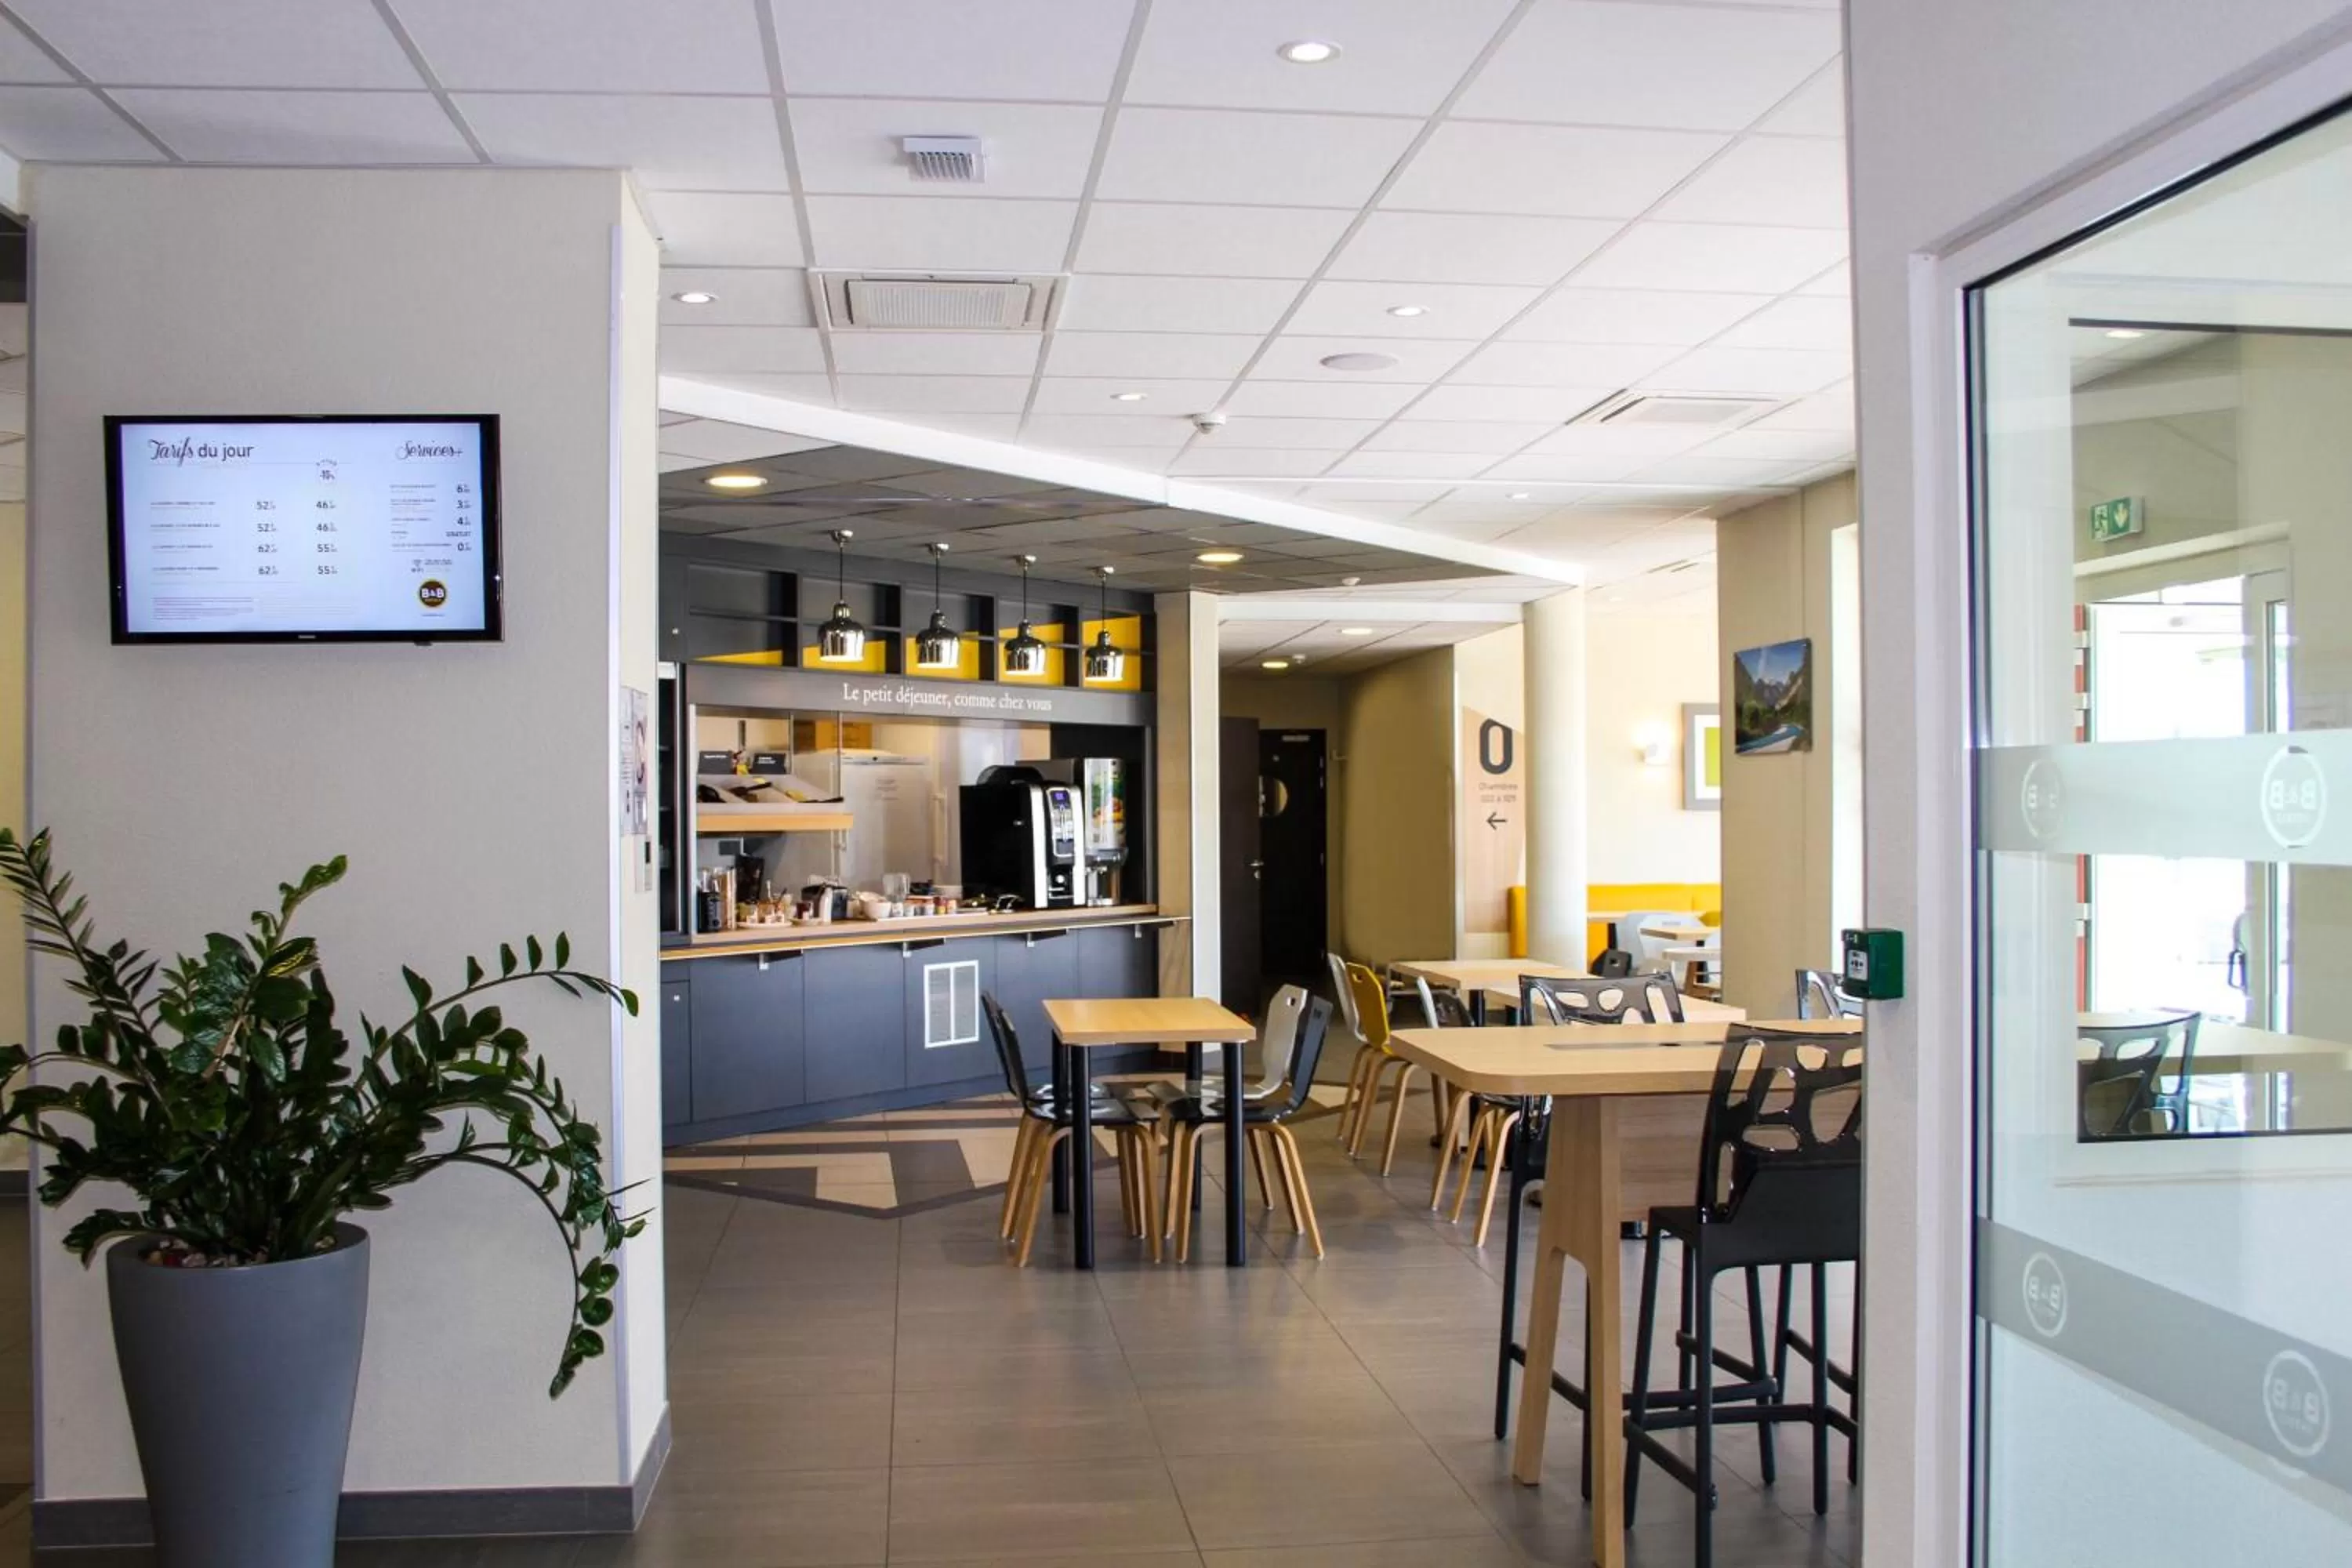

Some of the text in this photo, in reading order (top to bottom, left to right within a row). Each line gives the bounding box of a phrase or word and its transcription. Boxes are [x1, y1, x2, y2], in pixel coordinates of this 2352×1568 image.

[148, 437, 255, 467] Tarifs du jour
[842, 682, 1052, 711] Le petit déjeuner, comme chez vous
